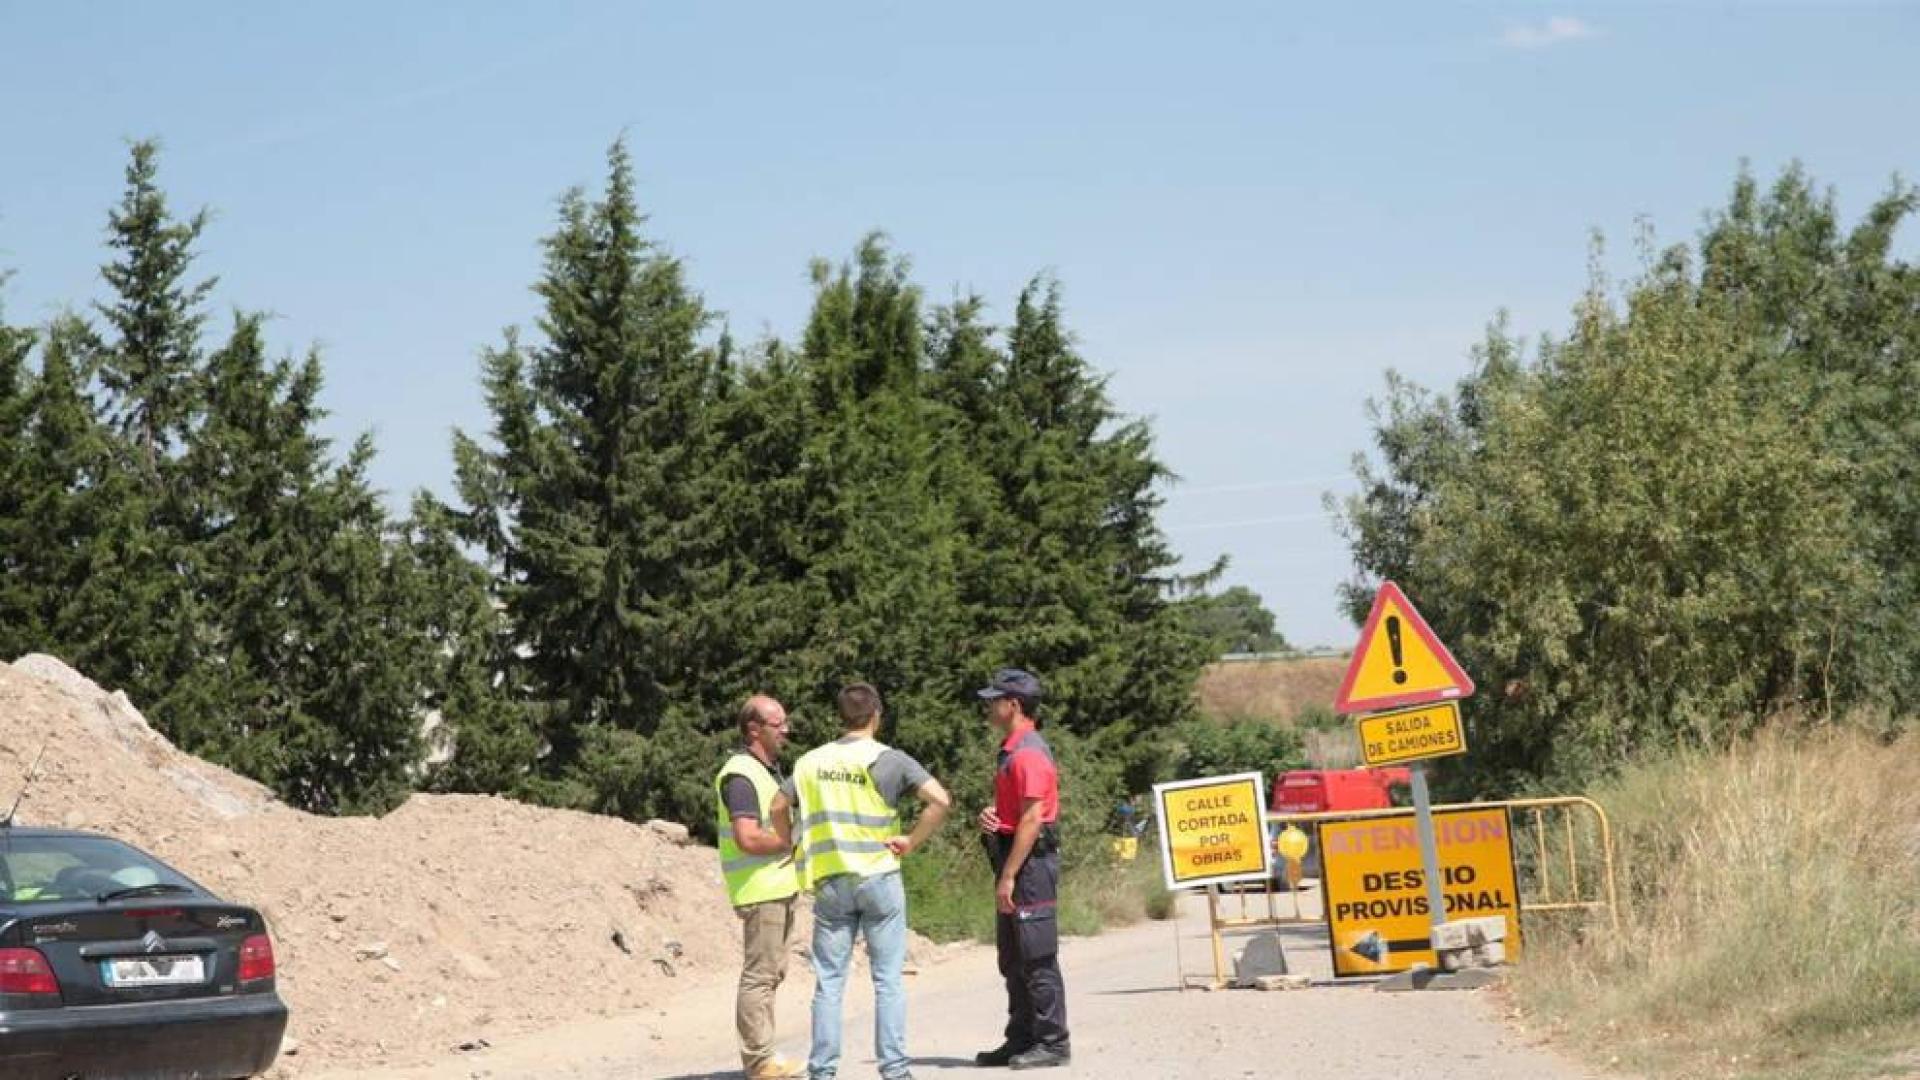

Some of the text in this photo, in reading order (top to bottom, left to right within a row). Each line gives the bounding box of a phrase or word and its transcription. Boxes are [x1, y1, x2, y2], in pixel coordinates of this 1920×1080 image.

[1386, 716, 1431, 735] SALIDA
[1368, 730, 1455, 757] DE CAMIONES
[1186, 795, 1232, 811] CALLE
[1177, 811, 1248, 832] CORTADA
[1200, 832, 1230, 847] POR
[1329, 816, 1504, 854] ATENION
[1192, 848, 1242, 866] OBRAS
[1363, 865, 1477, 892] DESIO
[1336, 890, 1512, 922] PROVISONAL
